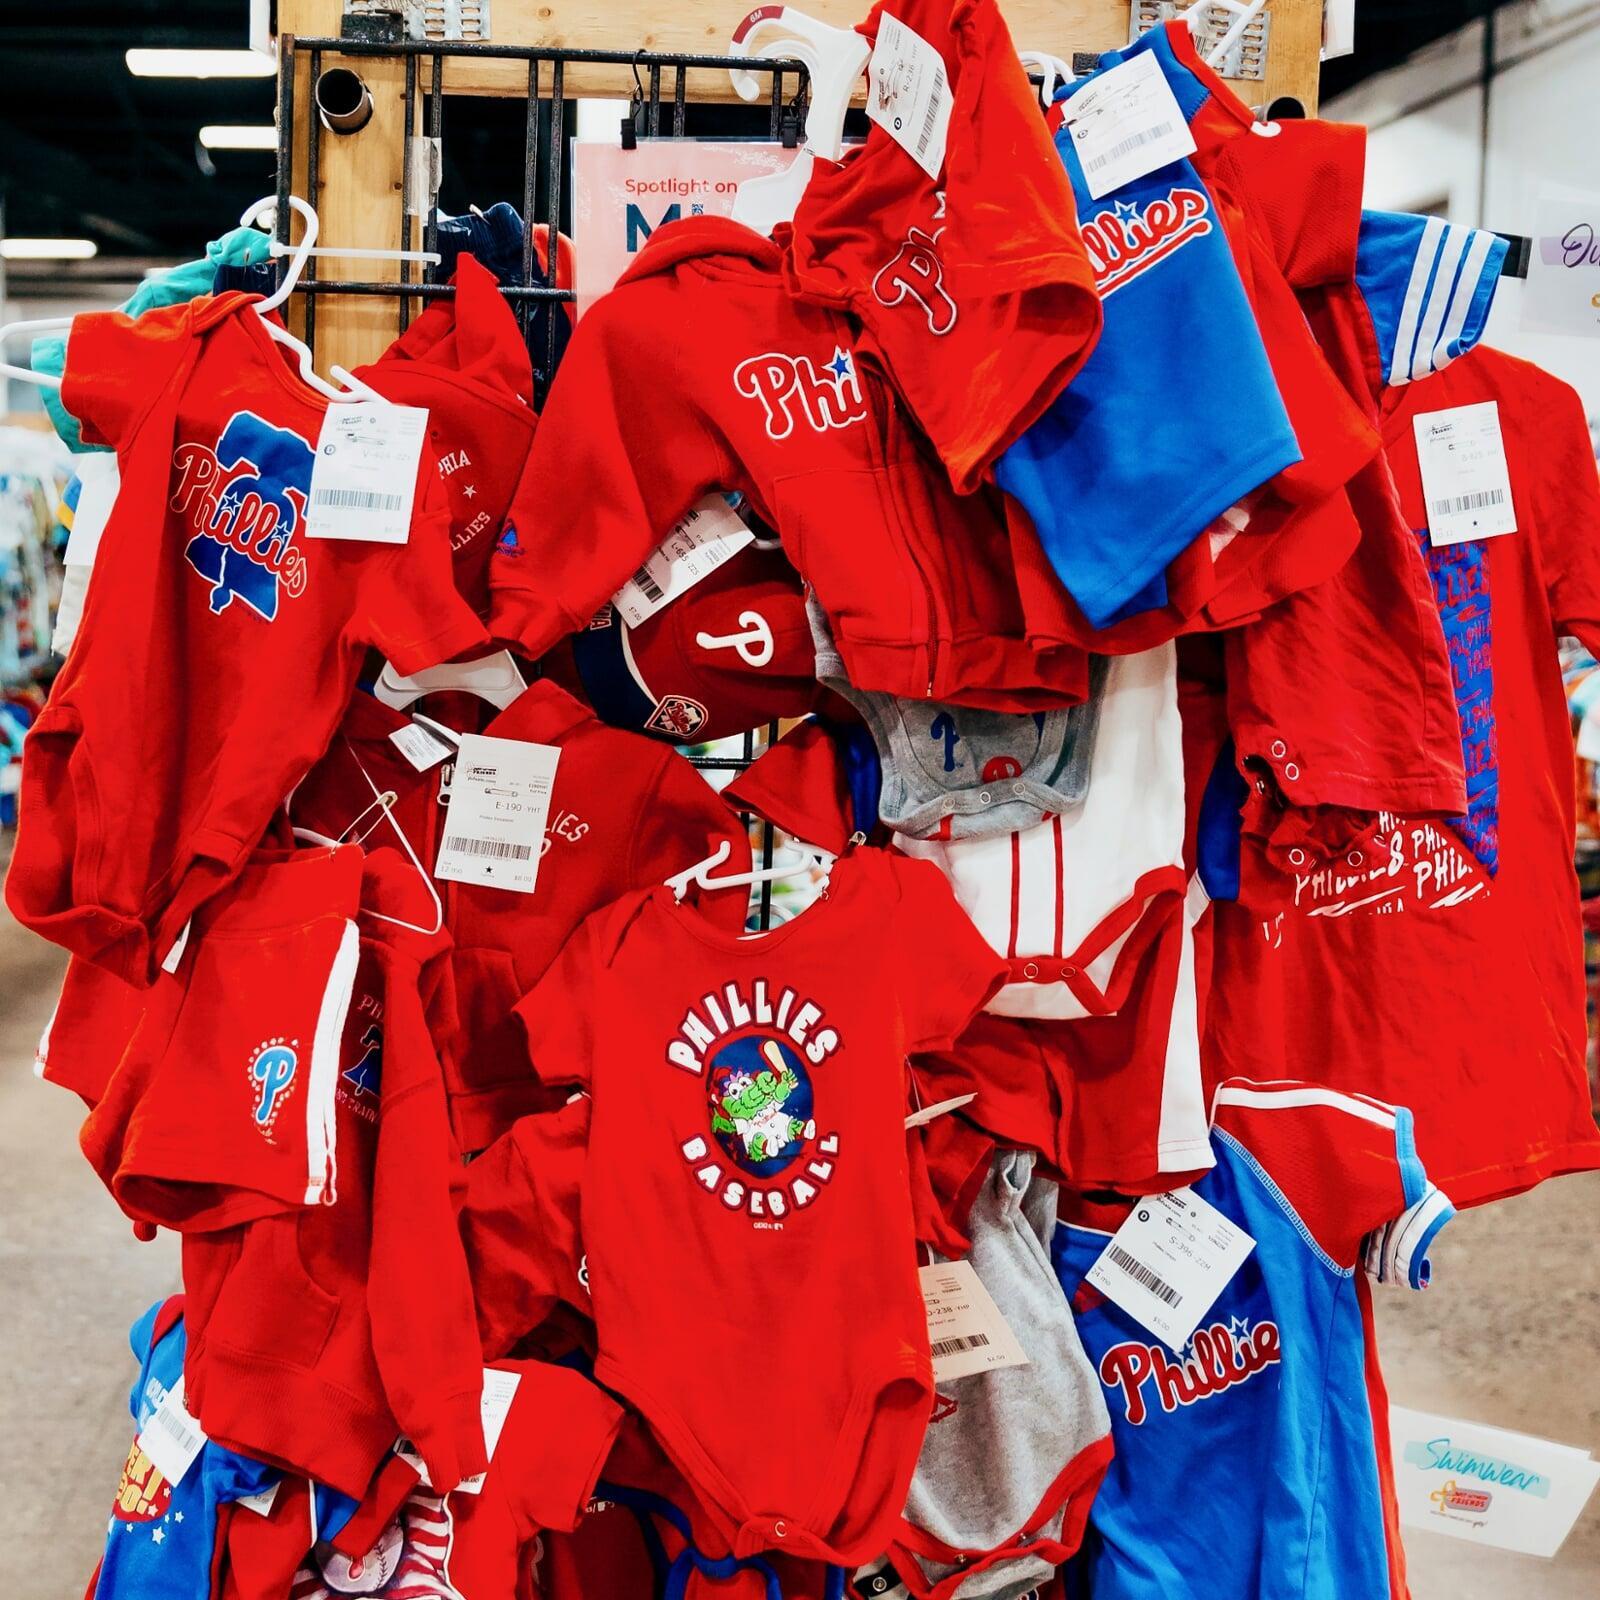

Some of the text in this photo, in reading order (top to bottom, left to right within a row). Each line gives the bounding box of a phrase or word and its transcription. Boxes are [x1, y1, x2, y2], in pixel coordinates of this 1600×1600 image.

[625, 178, 738, 197] Spotlight on
[170, 443, 307, 599] Phillies
[696, 610, 774, 667] P
[495, 801, 522, 812] E-190
[545, 809, 590, 842] IES
[666, 977, 842, 1078] PHILLIES
[253, 1046, 297, 1123] P
[681, 1132, 840, 1219] BASEBALL
[1169, 1236, 1193, 1258] S-396
[1417, 1437, 1540, 1491] Swimwear
